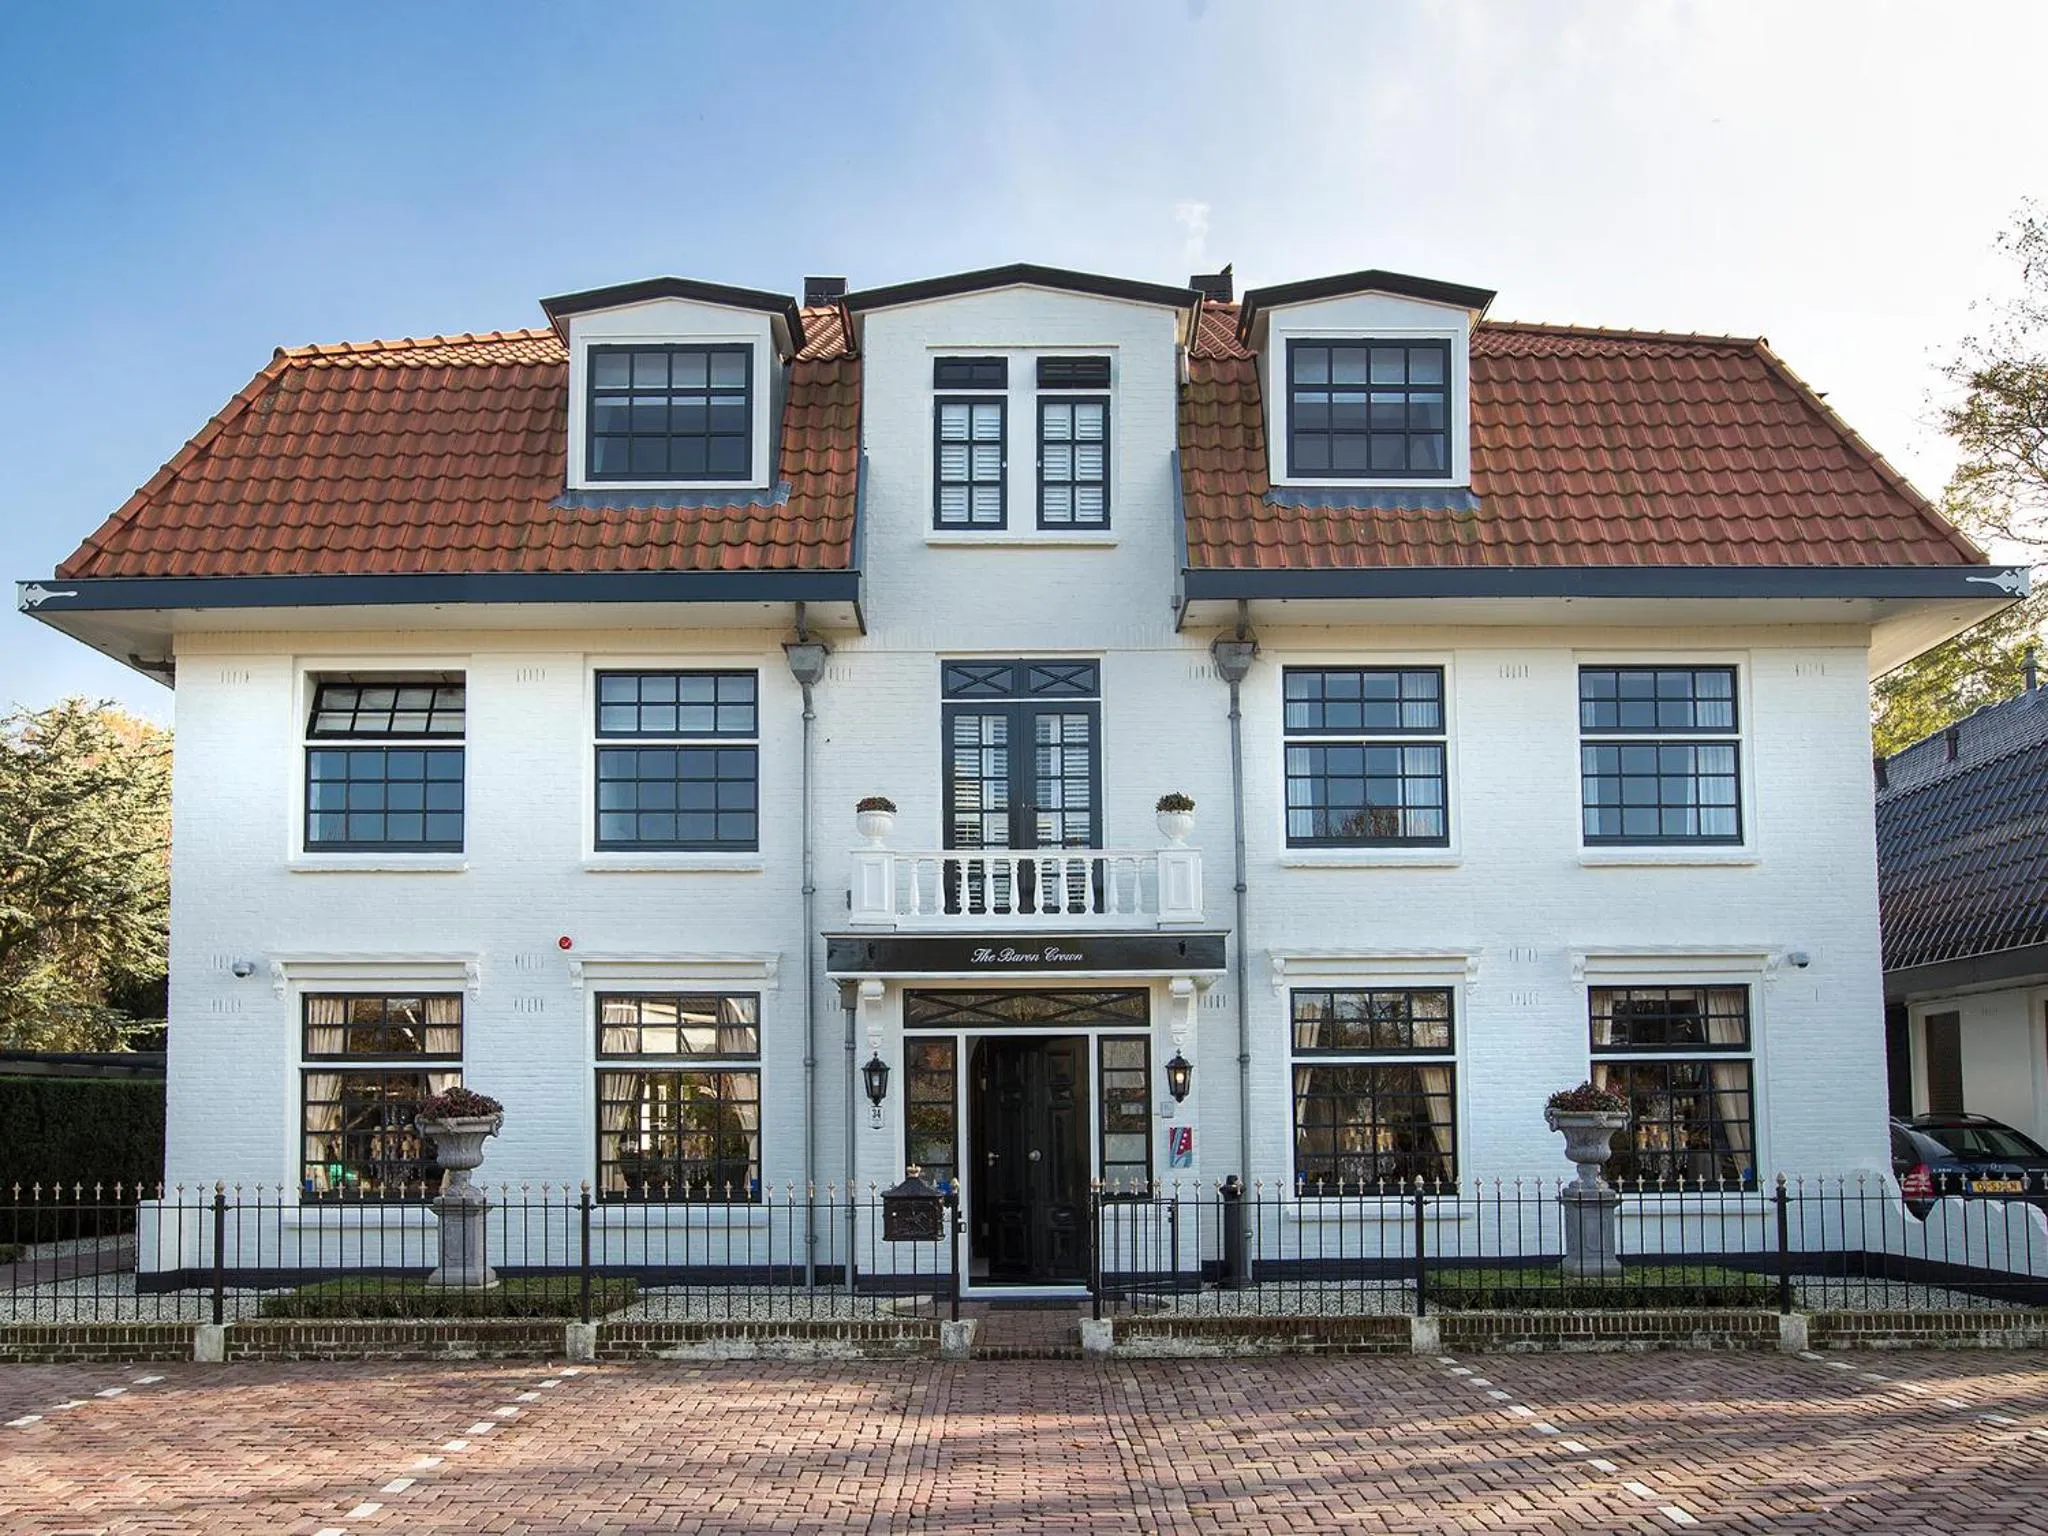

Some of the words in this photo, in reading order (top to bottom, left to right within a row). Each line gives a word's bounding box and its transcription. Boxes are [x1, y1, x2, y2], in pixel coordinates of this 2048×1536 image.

[970, 948, 996, 963] The
[997, 947, 1040, 962] Baron
[1043, 946, 1084, 962] Crown
